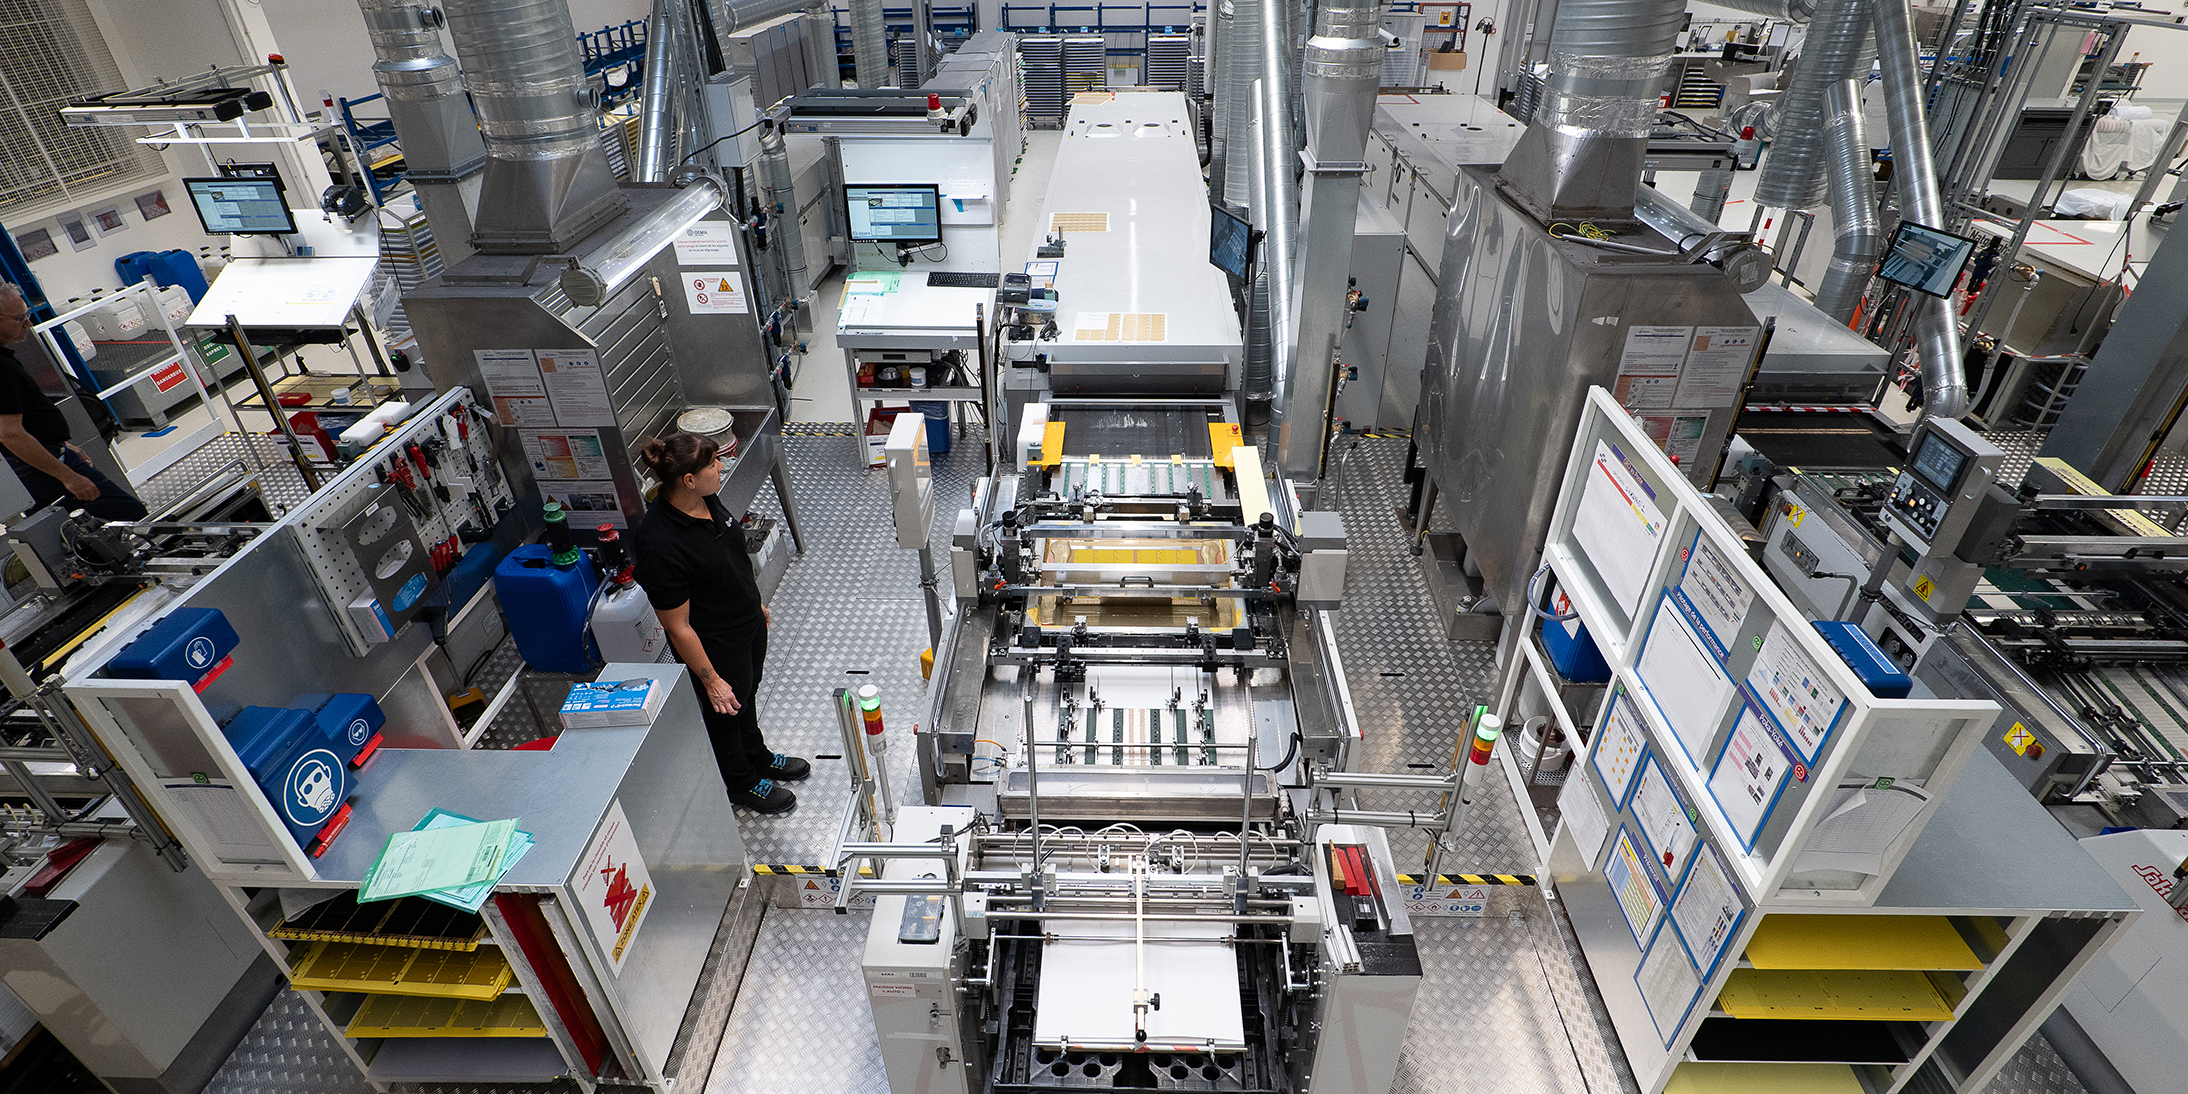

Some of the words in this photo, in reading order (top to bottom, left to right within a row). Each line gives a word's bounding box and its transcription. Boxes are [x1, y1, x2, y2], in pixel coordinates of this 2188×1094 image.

[1677, 591, 1692, 614] Pilotage
[1700, 623, 1725, 659] performance
[621, 921, 633, 946] ZONE
[631, 901, 643, 920] ATEX
